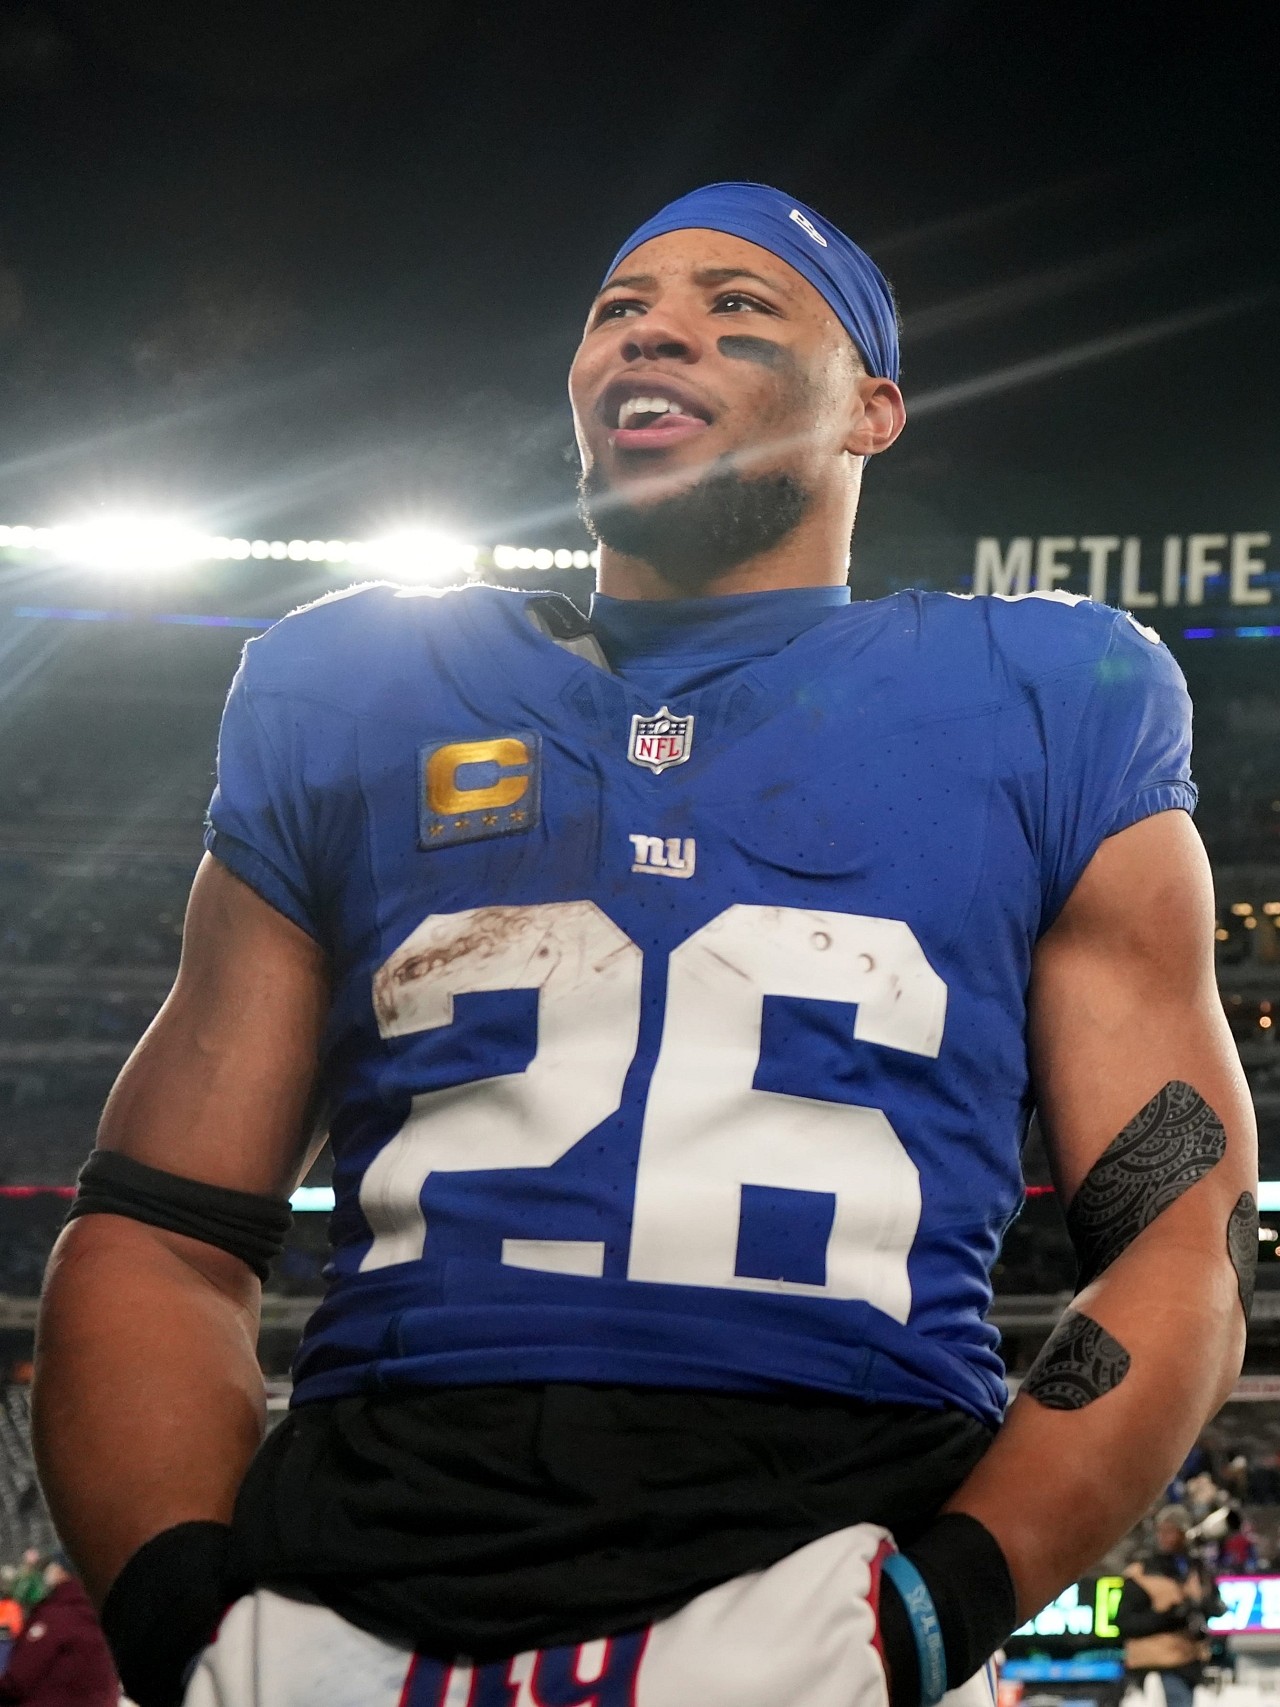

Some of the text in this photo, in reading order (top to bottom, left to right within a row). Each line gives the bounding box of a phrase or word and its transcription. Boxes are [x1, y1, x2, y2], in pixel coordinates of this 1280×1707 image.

[973, 531, 1272, 608] METLIFE
[426, 738, 530, 815] C
[638, 737, 681, 760] NFL
[358, 900, 948, 1326] 26
